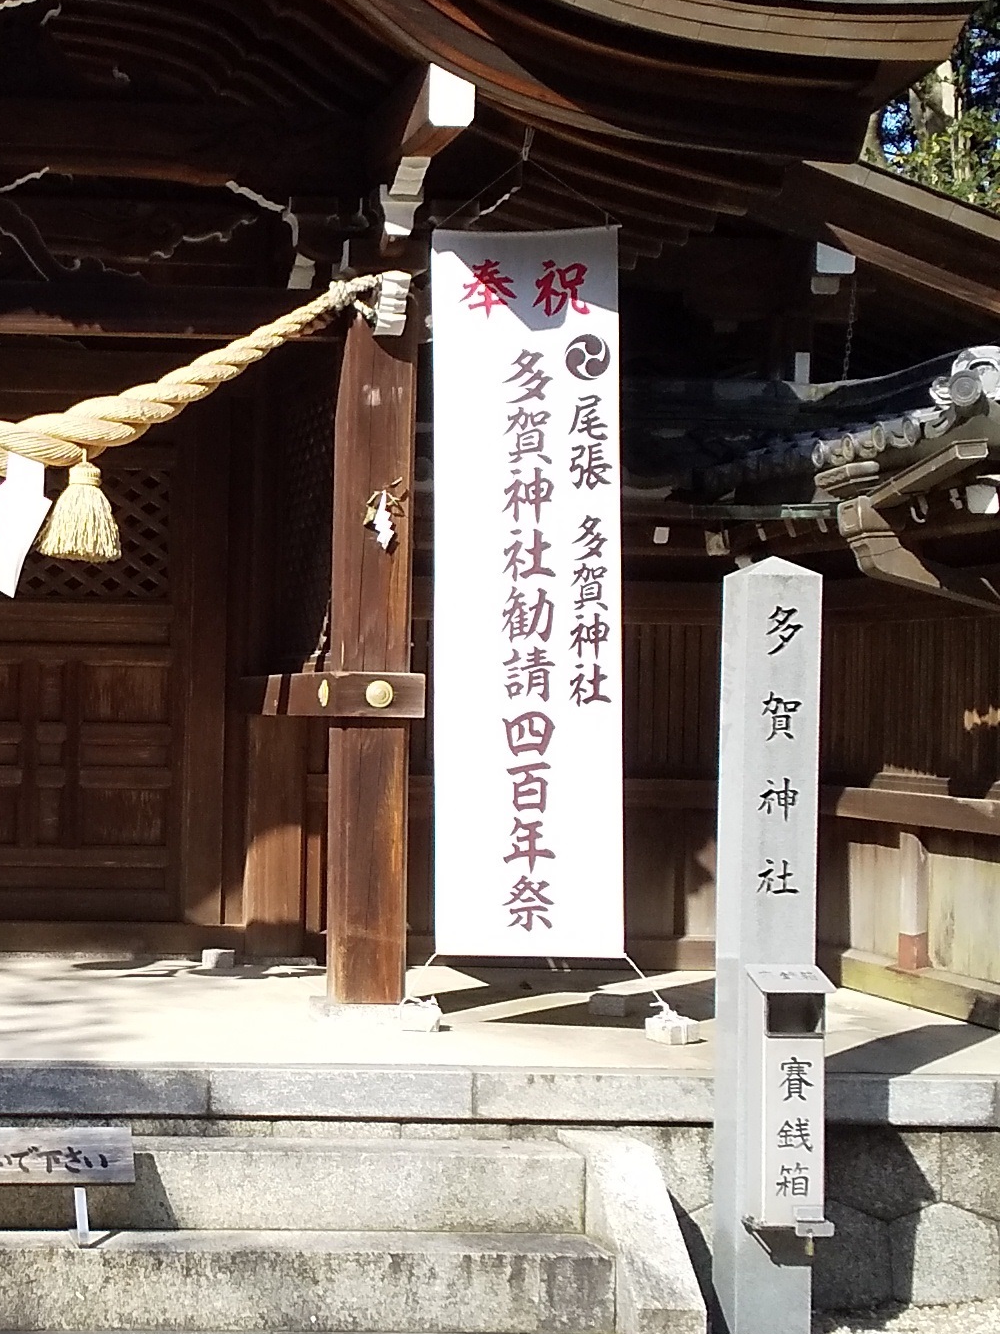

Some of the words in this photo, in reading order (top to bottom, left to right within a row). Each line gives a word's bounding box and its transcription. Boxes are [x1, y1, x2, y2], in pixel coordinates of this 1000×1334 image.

[459, 259, 590, 319] 奉祝
[568, 394, 612, 490] 尾張
[502, 349, 556, 932] 多賀神社勧請四百年祭
[568, 515, 612, 707] 多賀神社
[756, 605, 804, 895] 多賀神社
[776, 1056, 814, 1197] 賽銭箱
